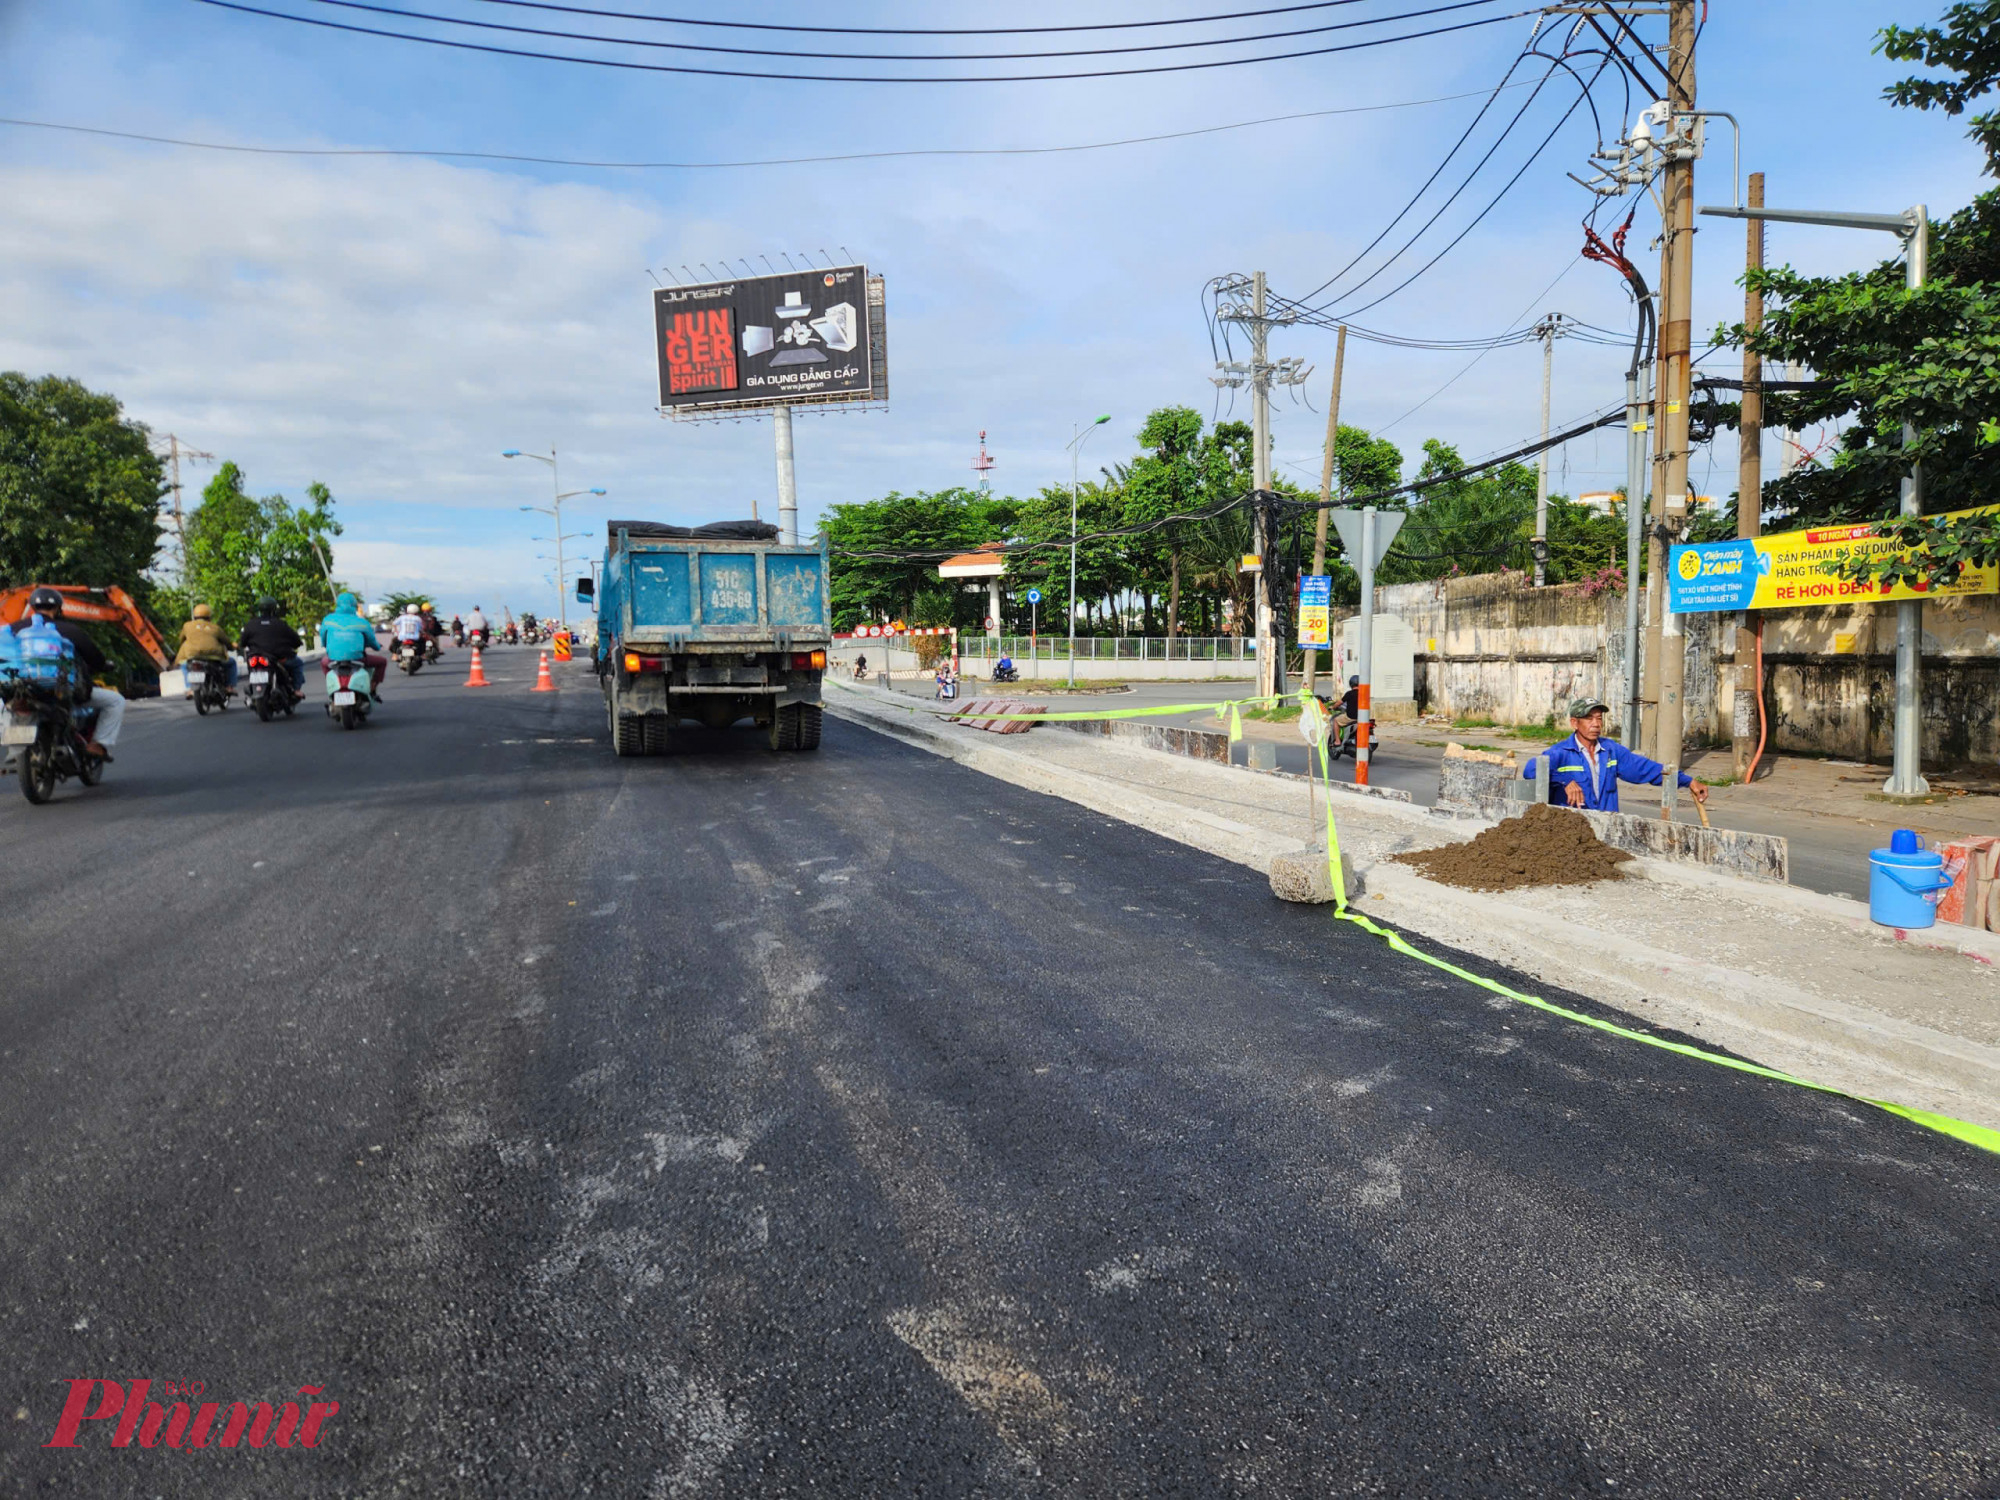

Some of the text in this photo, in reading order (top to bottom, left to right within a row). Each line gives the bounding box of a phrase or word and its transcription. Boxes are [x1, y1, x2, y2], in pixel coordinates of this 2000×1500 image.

[662, 284, 735, 303] JUNGER
[665, 308, 729, 339] JUN
[666, 334, 735, 365] GER
[670, 369, 718, 394] spirit
[767, 373, 798, 387] DỤNG
[800, 367, 832, 382] ĐẲNG
[834, 363, 859, 379] CẤP
[1818, 532, 1827, 541] 10
[1777, 551, 1798, 564] SẢN
[1800, 546, 1833, 562] PHẨM
[1854, 541, 1870, 556] SỬ
[1701, 560, 1743, 577] XANH
[1776, 565, 1806, 579] HÀNG
[1776, 577, 1874, 600] RẺ HƠN ĐẾN
